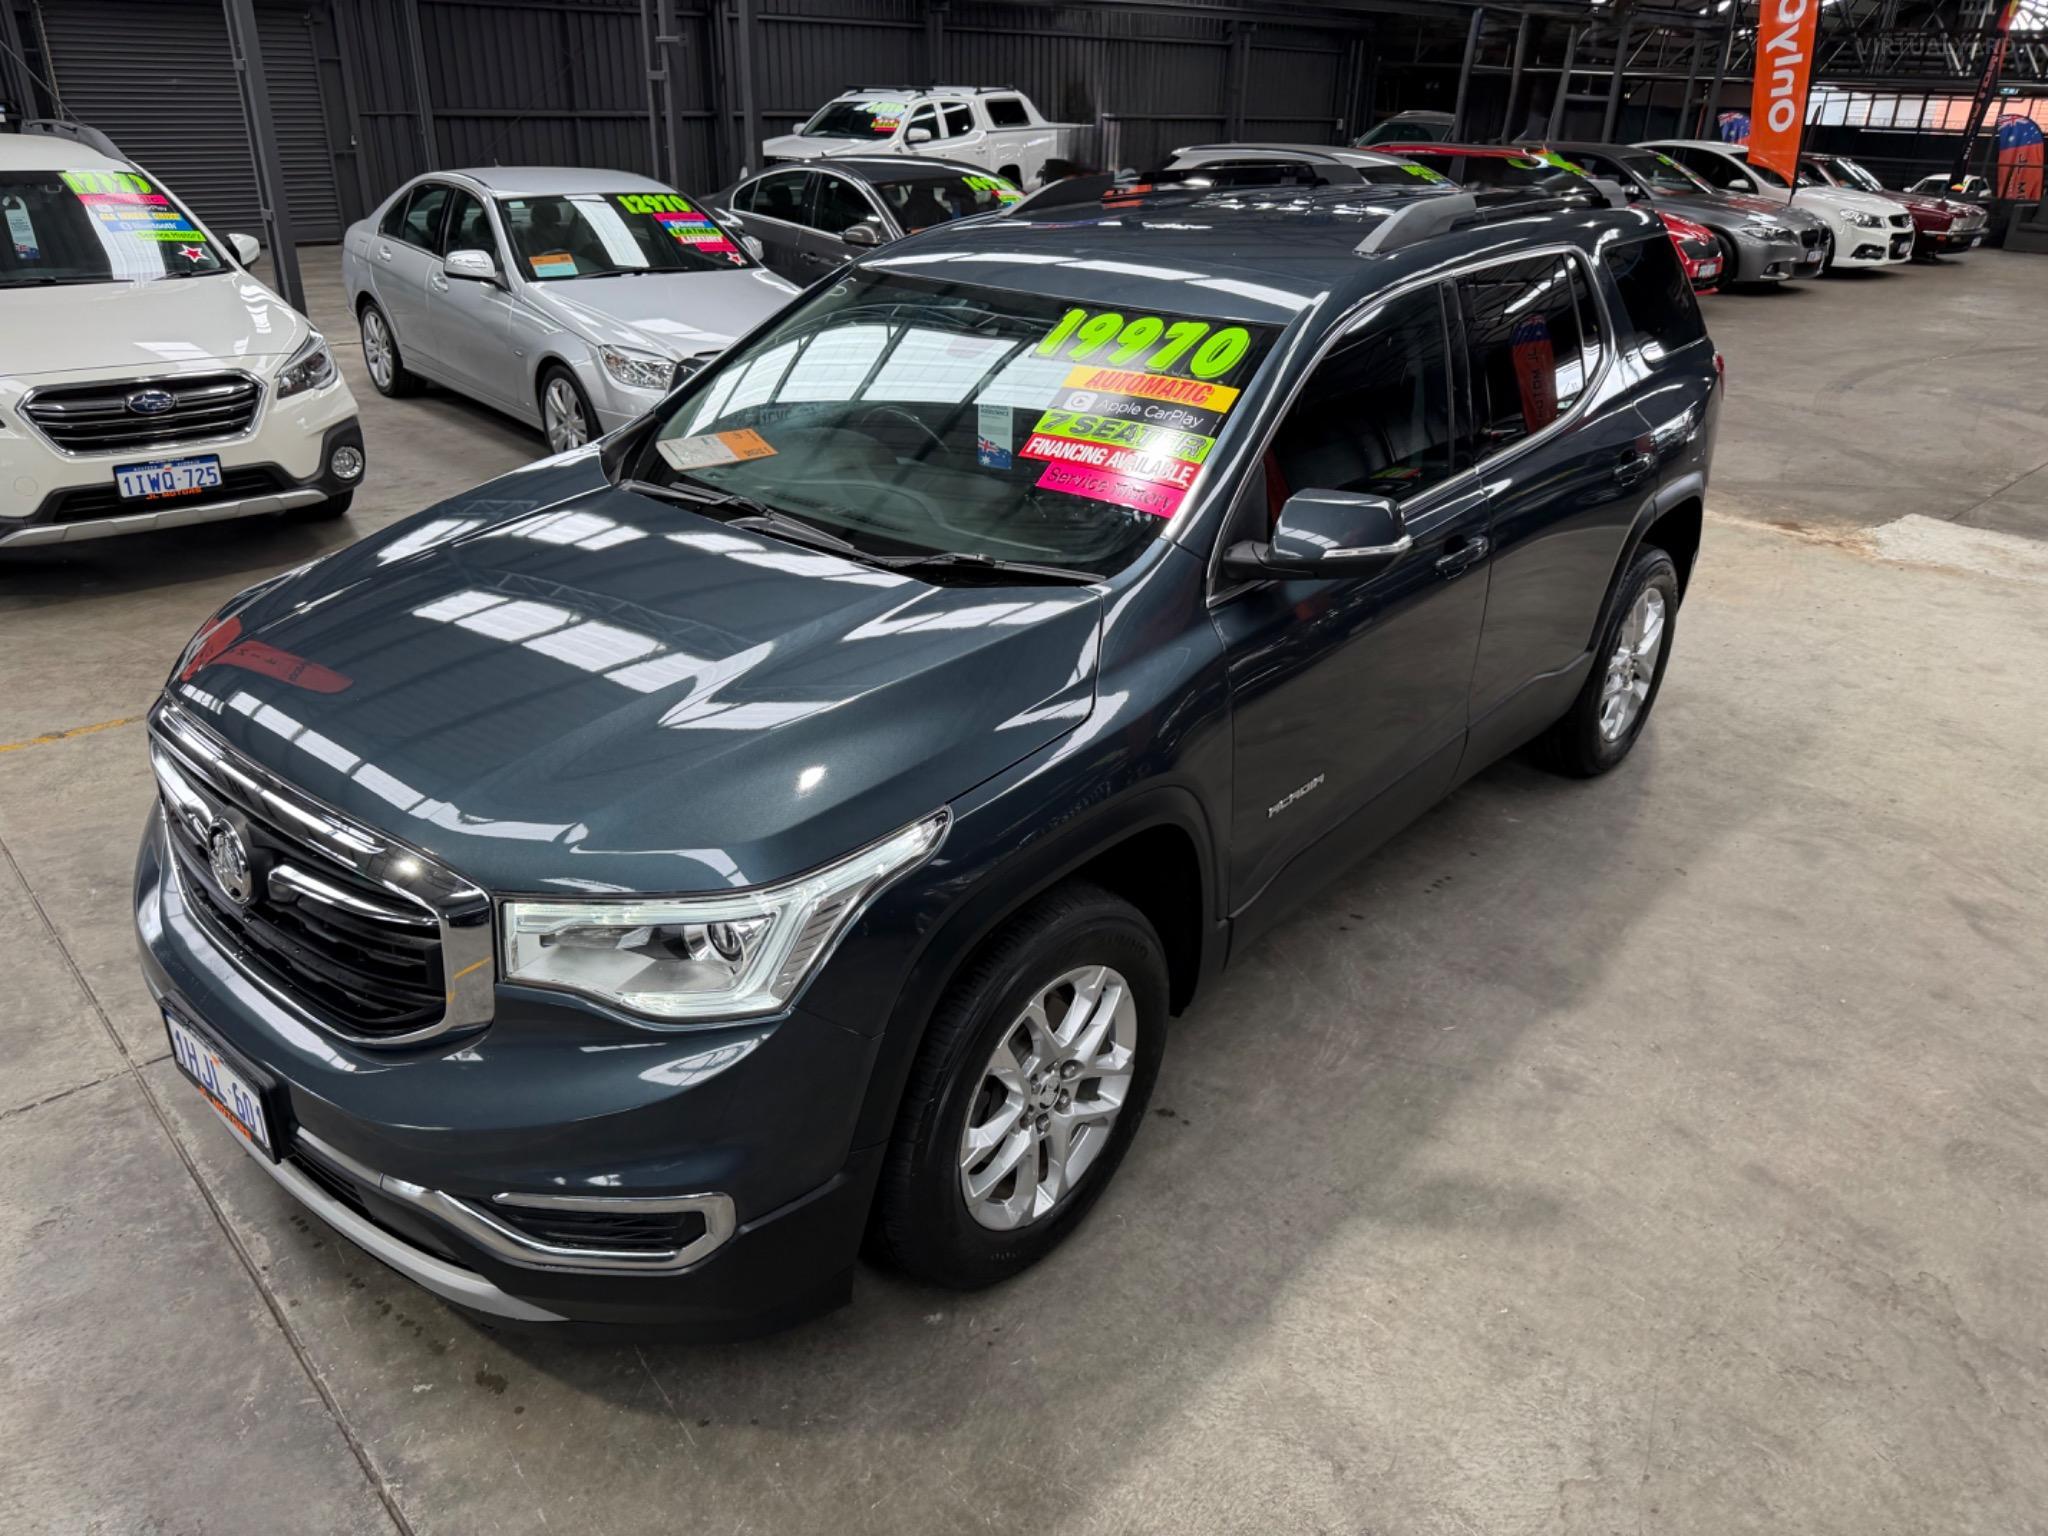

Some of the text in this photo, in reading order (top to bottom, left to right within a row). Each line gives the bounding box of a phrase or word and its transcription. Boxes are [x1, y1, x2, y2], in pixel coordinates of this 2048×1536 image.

[616, 195, 693, 214] 12970
[1036, 308, 1250, 378] 19970
[1084, 369, 1214, 405] AUTOMATIC
[1041, 412, 1071, 430] 7
[1096, 399, 1204, 429] Apple CarPlay
[1026, 437, 1194, 486] FINANCING AVAILABLE
[1046, 466, 1109, 492] Service
